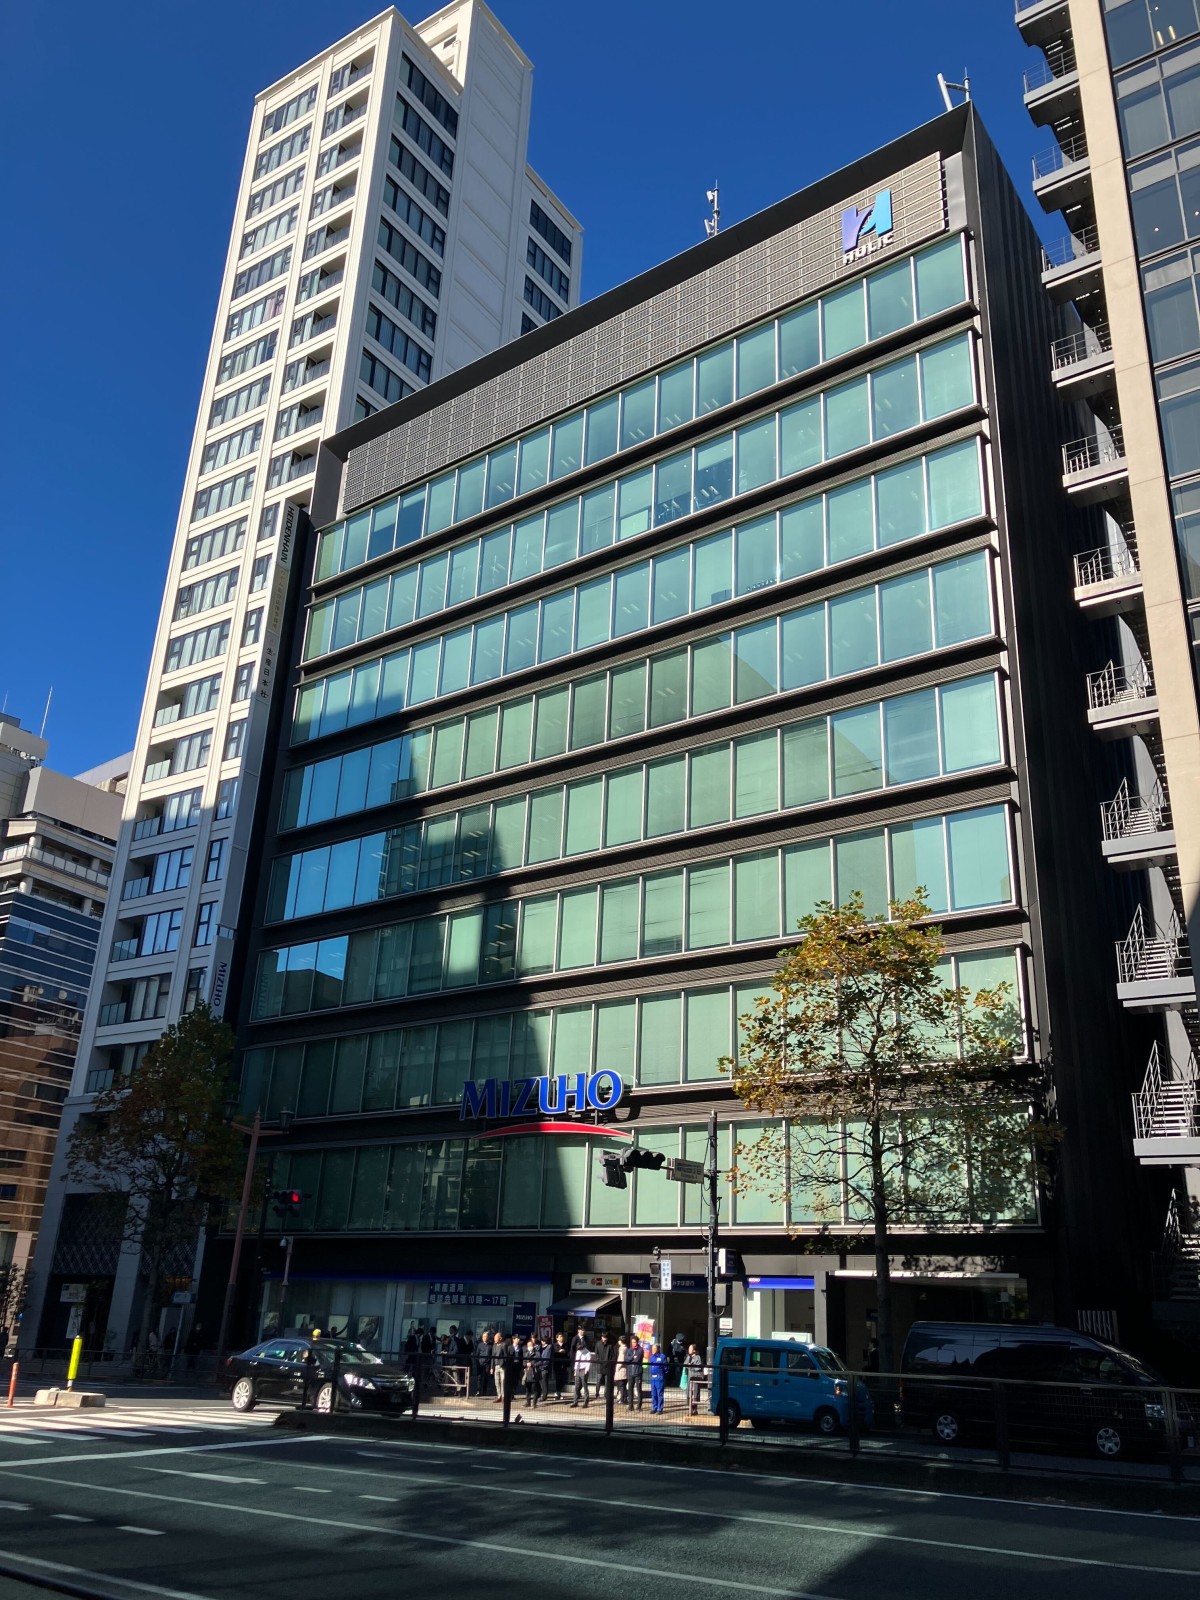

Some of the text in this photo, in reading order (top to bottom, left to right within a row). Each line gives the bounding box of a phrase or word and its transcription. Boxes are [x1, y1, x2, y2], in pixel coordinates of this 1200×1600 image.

[843, 233, 894, 264] HULIC
[280, 506, 294, 563] HEIDENHAIN
[260, 647, 273, 699] 生産日本社
[213, 961, 227, 1007] MIZUHO
[459, 1069, 623, 1121] MIZUHO
